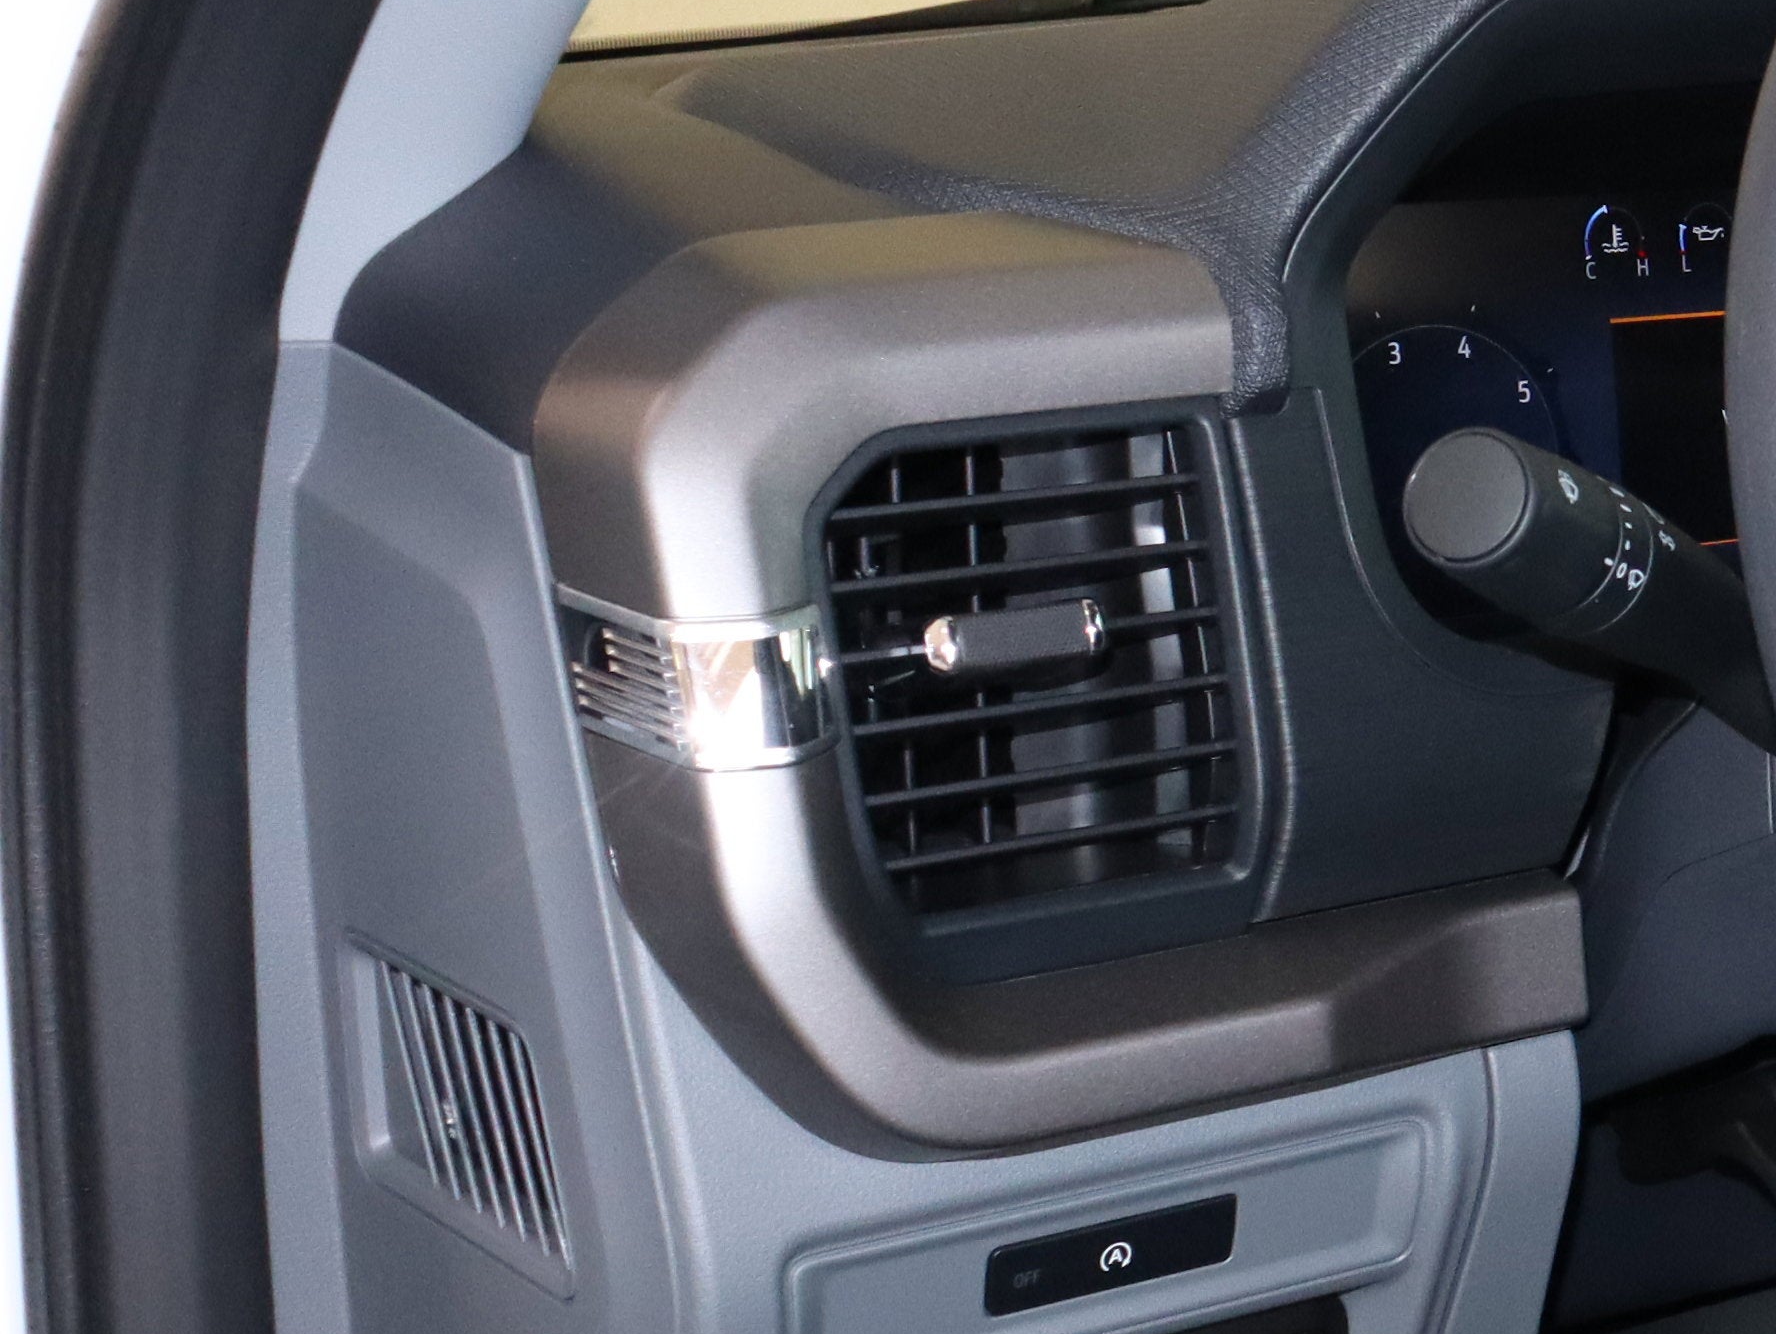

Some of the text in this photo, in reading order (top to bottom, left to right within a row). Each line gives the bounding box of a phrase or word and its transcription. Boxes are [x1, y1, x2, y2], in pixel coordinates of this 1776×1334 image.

[1586, 258, 1650, 280] C H
[1681, 255, 1692, 273] L
[1387, 341, 1402, 365] 3
[1457, 335, 1472, 359] 4
[1517, 379, 1532, 403] 5
